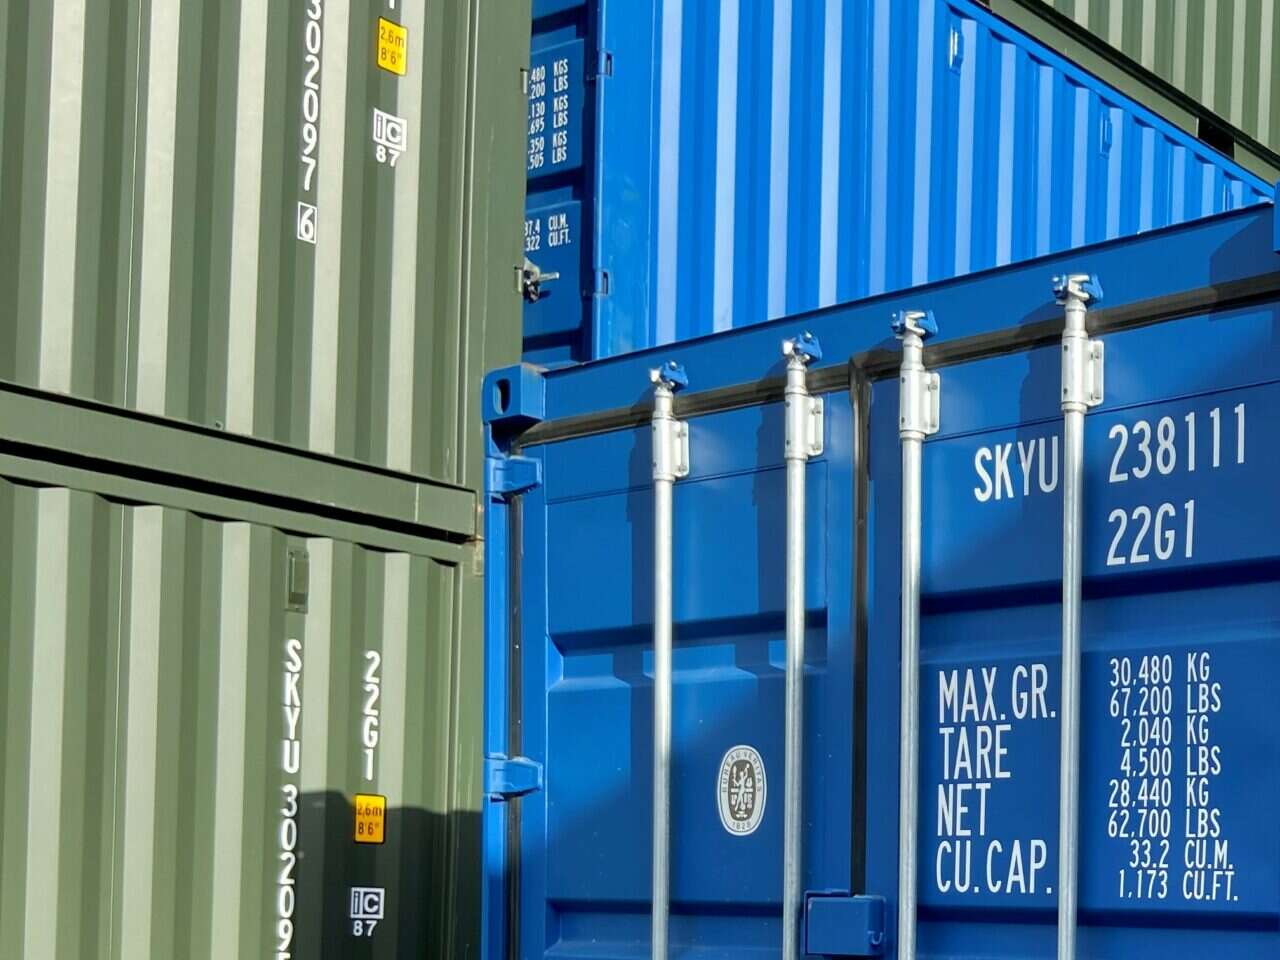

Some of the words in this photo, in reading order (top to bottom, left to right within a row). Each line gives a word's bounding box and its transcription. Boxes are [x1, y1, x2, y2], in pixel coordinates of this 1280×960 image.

[528, 65, 546, 83] .480
[553, 59, 568, 75] KGS
[528, 82, 546, 99] .200
[553, 75, 568, 93] LBS
[528, 101, 545, 119] .130
[553, 95, 568, 112] KGS
[553, 111, 568, 128] LBS
[376, 146, 400, 167] 87
[527, 136, 544, 154] .350
[552, 131, 567, 148] KGS
[527, 153, 544, 170] .505
[552, 146, 567, 164] LBS
[974, 436, 1059, 502] SKYU
[1108, 402, 1246, 483] 238111
[1106, 499, 1195, 566] 22G1
[1186, 652, 1211, 683] KG
[283, 638, 303, 774] SKYU
[1186, 682, 1222, 714] LBS
[363, 651, 381, 780] 22G1
[939, 724, 1012, 780] TARE
[1186, 715, 1210, 745] KG
[1186, 745, 1222, 776] LBS
[937, 782, 992, 836] NET
[1186, 777, 1210, 807] KG
[1185, 808, 1221, 838] LBS
[935, 839, 1053, 894] CU.CAP.
[1128, 839, 1169, 869] 33.2
[1184, 838, 1234, 870] CU.M.
[1182, 869, 1239, 901] CU.FT.
[353, 920, 377, 937] 87
